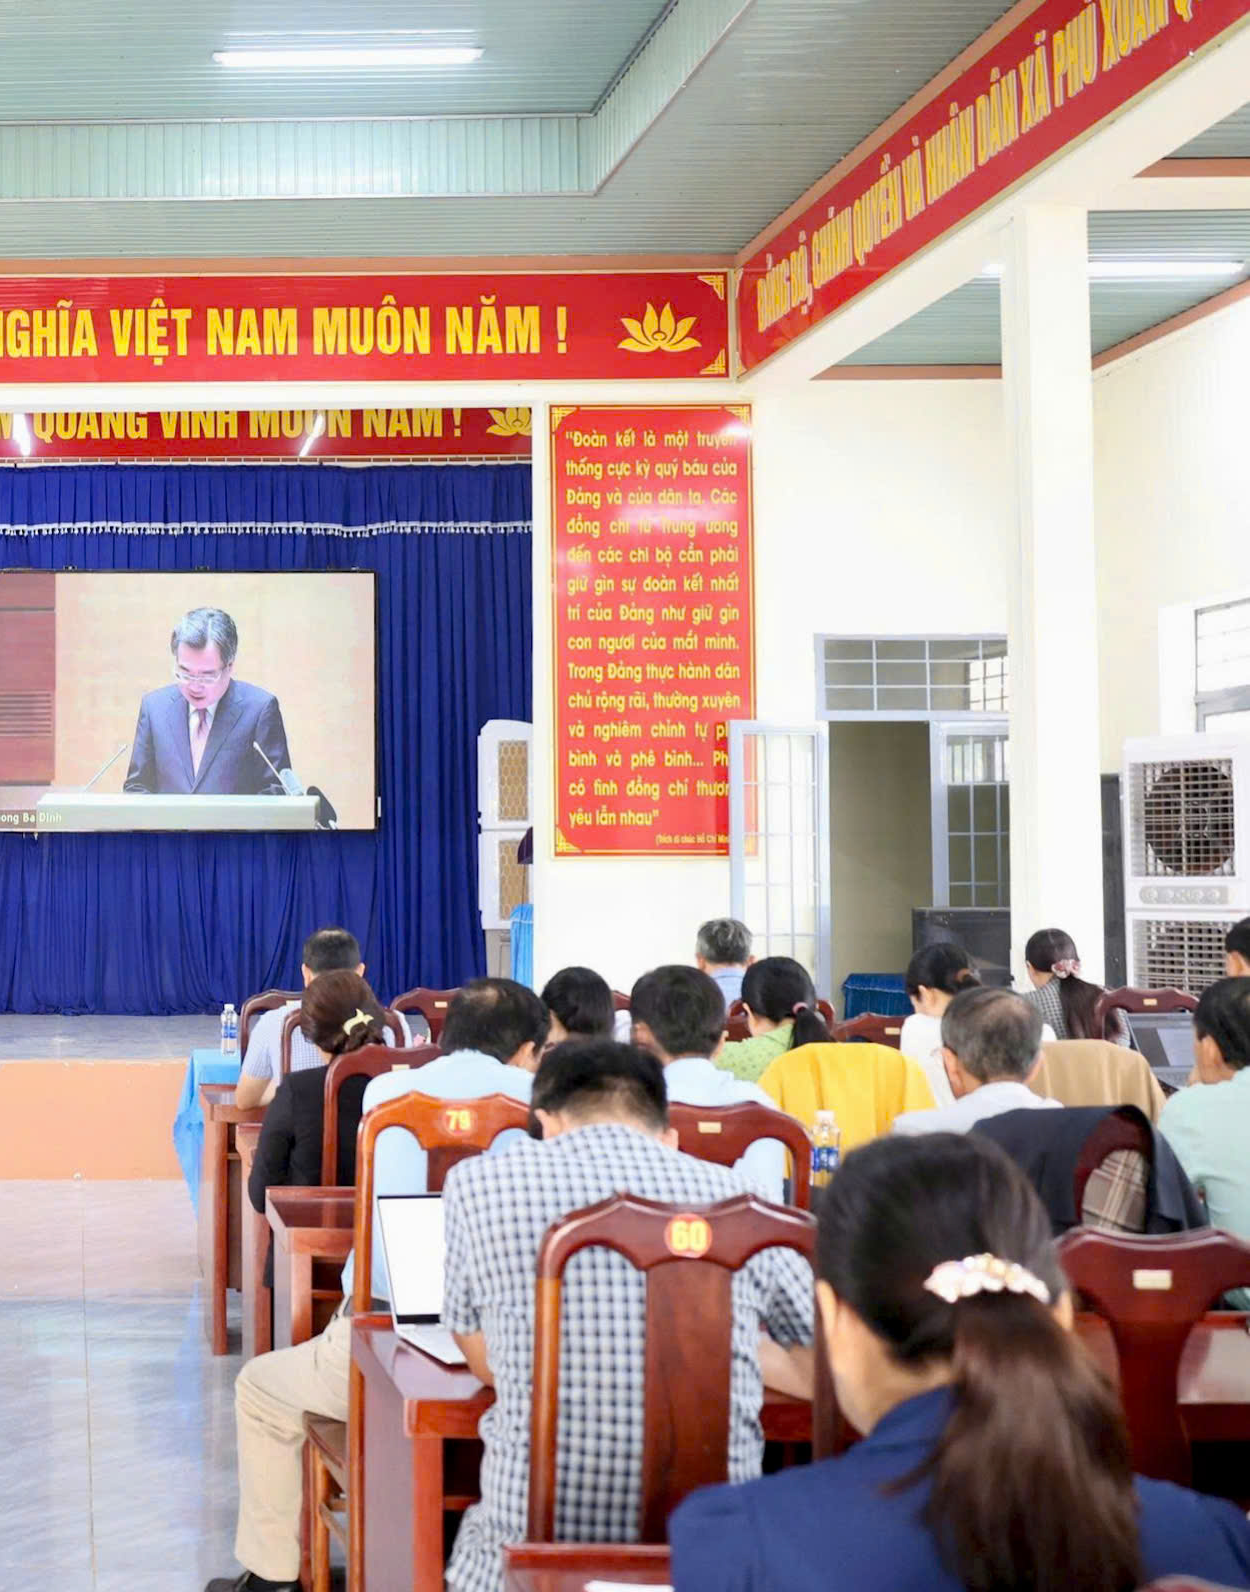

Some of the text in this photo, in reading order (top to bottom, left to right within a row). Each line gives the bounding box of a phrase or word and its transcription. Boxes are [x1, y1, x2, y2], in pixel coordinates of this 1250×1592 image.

[812, 206, 854, 289] CHÍNH
[853, 153, 903, 267] QUYỀN
[901, 135, 927, 222] VÀ
[925, 101, 976, 206] NHÂN
[975, 67, 1020, 167] DÂN
[1018, 29, 1052, 134] XÃ
[109, 298, 193, 366] VIỆT
[206, 307, 298, 357] NAM
[312, 295, 432, 357] MUÔN
[445, 294, 541, 356] NĂM
[556, 305, 568, 355] !
[22, 811, 36, 823] Ba
[670, 1221, 707, 1251] 60
